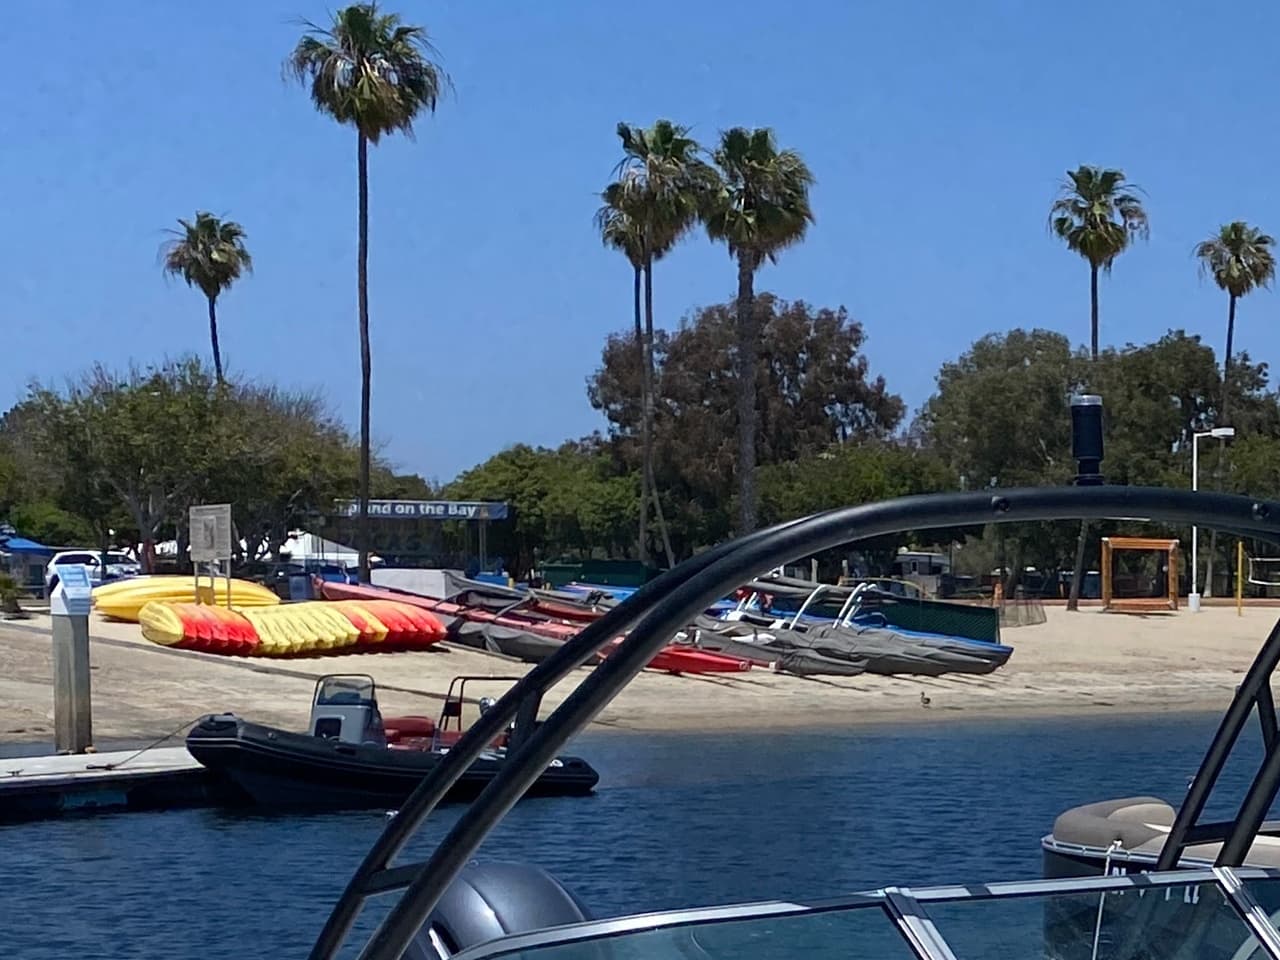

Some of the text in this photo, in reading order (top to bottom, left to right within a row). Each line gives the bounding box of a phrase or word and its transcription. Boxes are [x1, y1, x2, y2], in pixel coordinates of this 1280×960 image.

[395, 504, 415, 514] on
[419, 502, 444, 515] the
[448, 503, 477, 519] Bay
